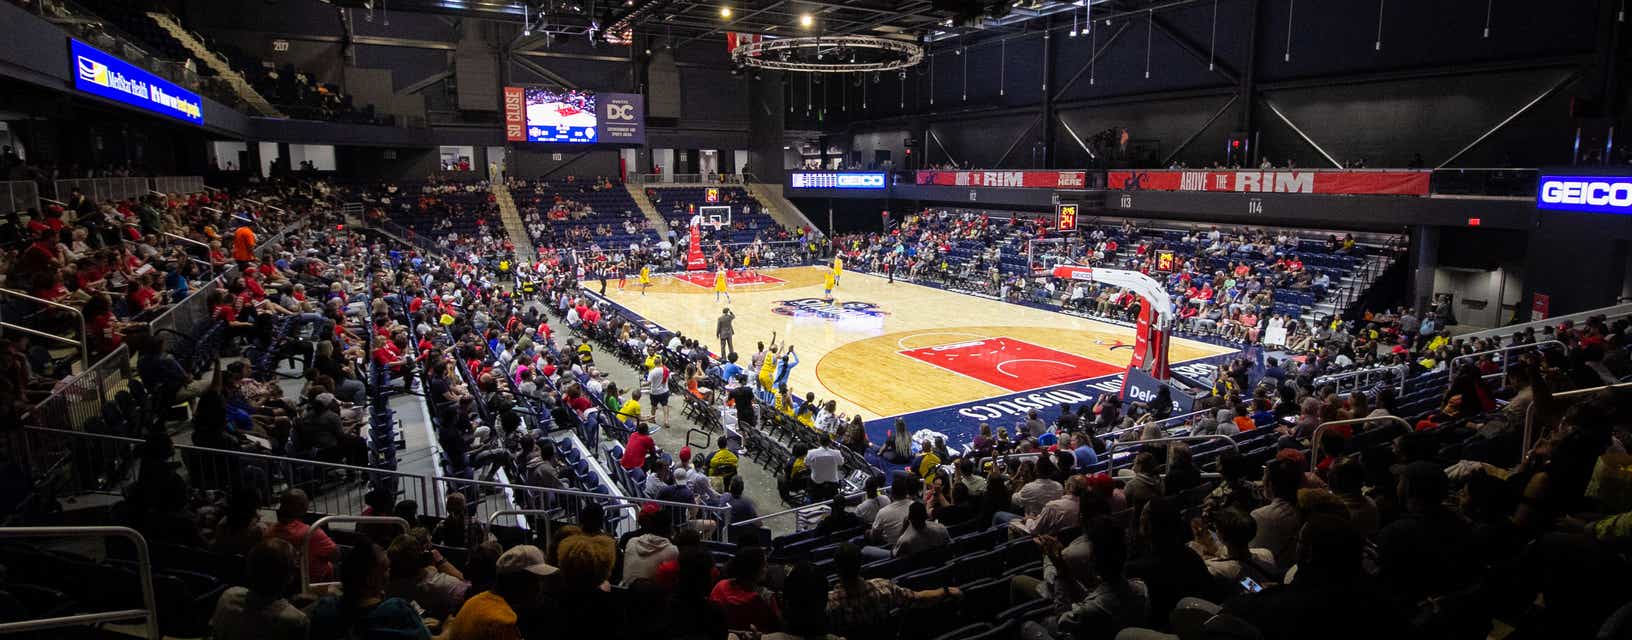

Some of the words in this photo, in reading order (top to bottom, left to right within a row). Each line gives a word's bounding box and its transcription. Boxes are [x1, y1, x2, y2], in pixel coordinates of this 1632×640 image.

[273, 41, 288, 51] 207
[506, 91, 520, 121] CLOSE
[607, 104, 634, 120] DC
[508, 124, 521, 137] SO
[838, 175, 883, 186] GEICO
[984, 172, 1024, 187] RIM
[1180, 172, 1208, 191] ABOVE
[1216, 174, 1228, 189] THE
[1235, 172, 1314, 193] RIM
[1542, 180, 1632, 207] GEICO
[1120, 197, 1132, 208] 113
[1249, 201, 1263, 214] 114
[1061, 215, 1073, 229] 24
